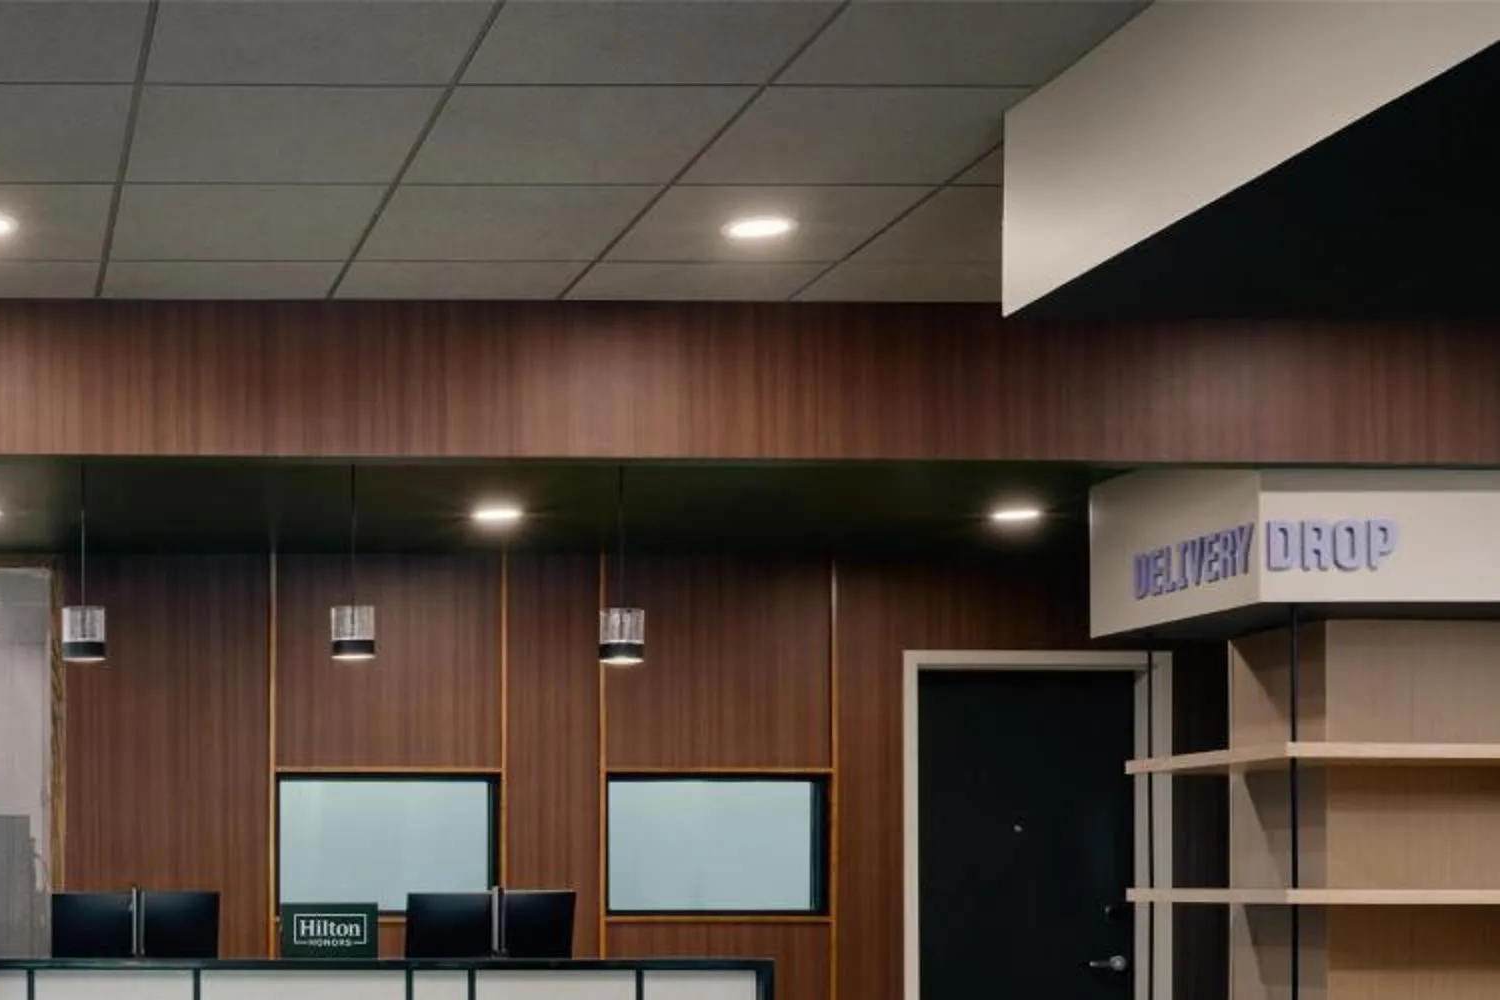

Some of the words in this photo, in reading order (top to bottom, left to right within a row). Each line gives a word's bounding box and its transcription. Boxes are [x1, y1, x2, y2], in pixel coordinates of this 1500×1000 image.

[1134, 523, 1254, 600] DELIVERY
[1266, 519, 1398, 572] DROP
[300, 919, 361, 937] Hilton
[308, 939, 352, 947] HONORS
